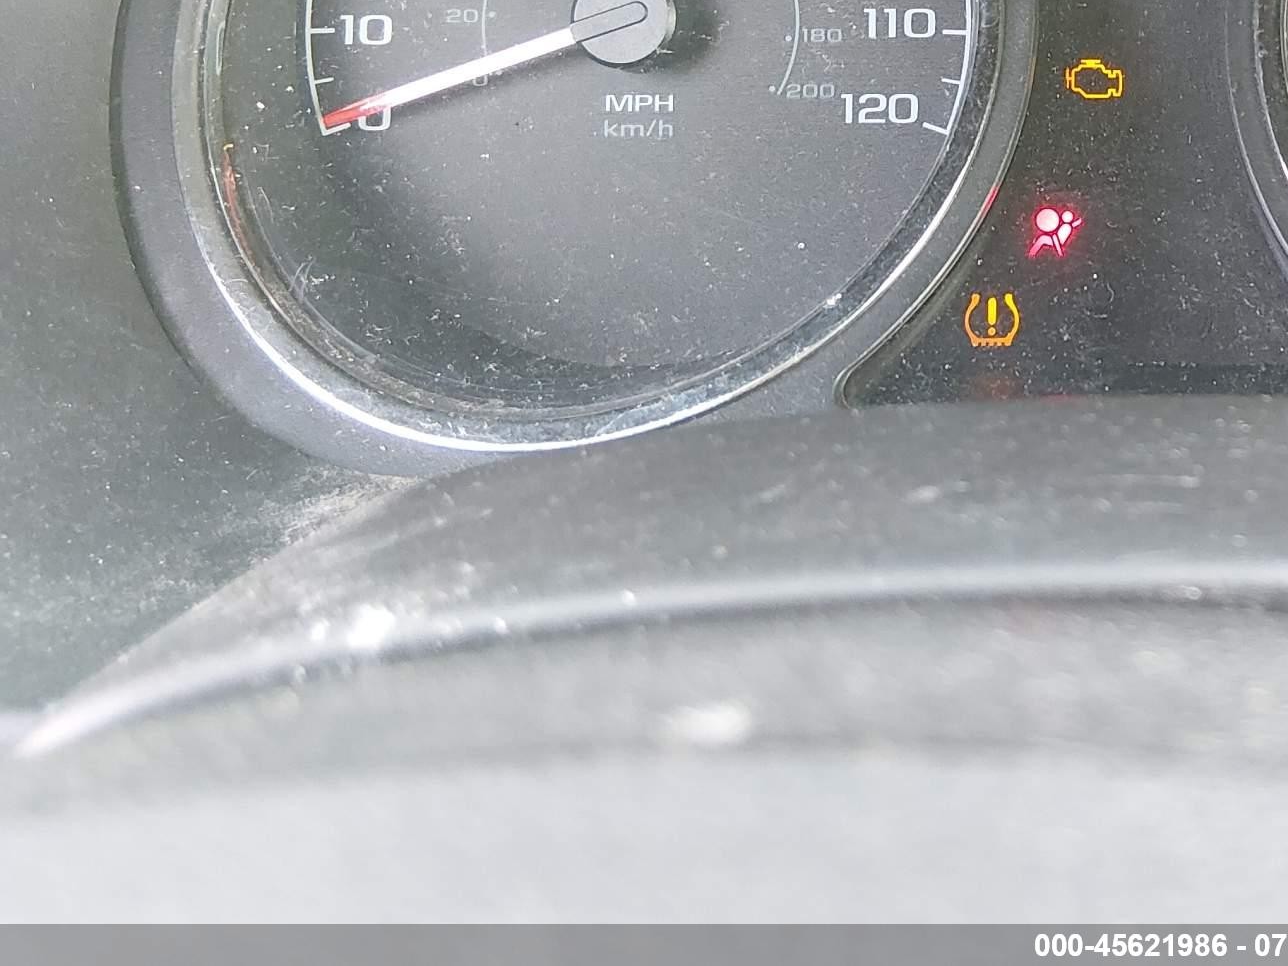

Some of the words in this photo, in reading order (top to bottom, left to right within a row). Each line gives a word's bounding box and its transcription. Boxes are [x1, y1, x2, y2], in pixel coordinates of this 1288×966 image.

[446, 9, 479, 23] 20
[863, 8, 936, 38] 110
[340, 15, 393, 45] 10
[801, 29, 842, 43] 180
[785, 84, 835, 99] 200
[605, 95, 674, 112] MPH
[841, 94, 919, 124] 120
[603, 119, 674, 137] km/h
